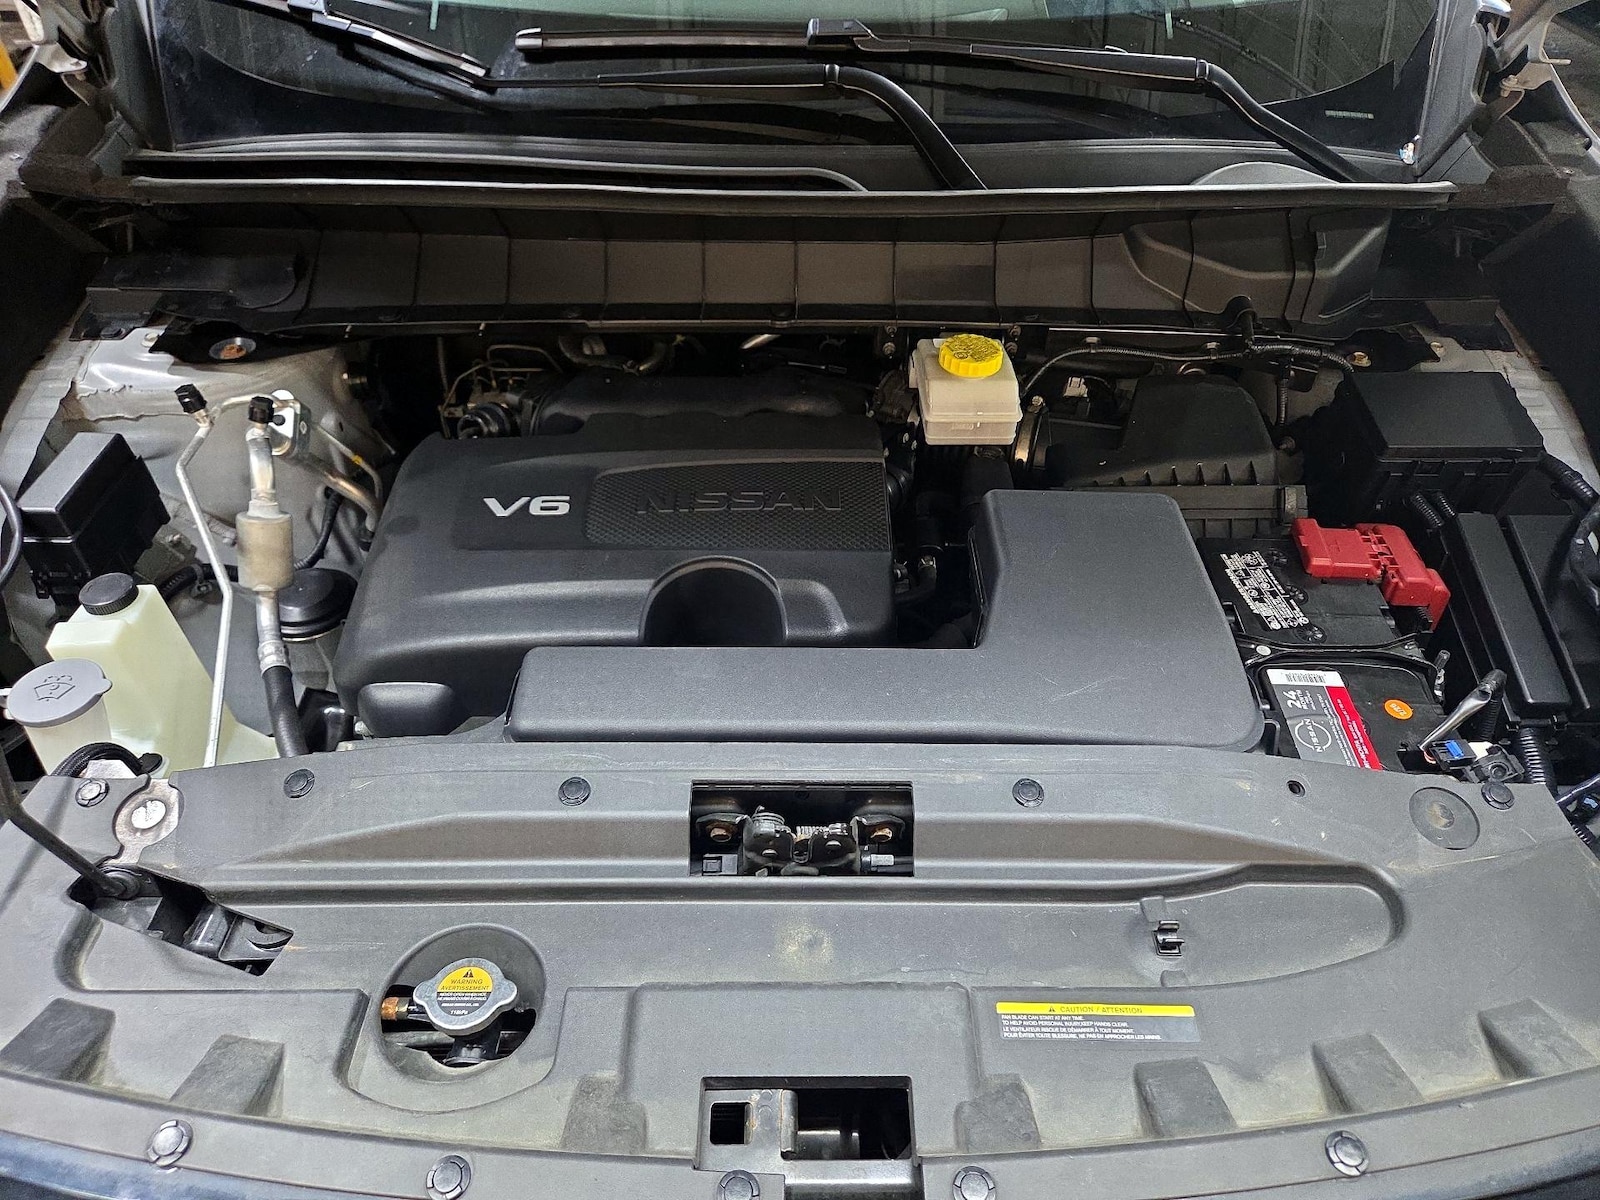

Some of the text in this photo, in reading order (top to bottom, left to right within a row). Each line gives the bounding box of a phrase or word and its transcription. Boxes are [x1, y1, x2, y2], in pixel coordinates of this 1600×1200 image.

[483, 488, 842, 517] V6 NISSAN
[1283, 690, 1302, 709] 24
[1304, 718, 1323, 753] NISSAN
